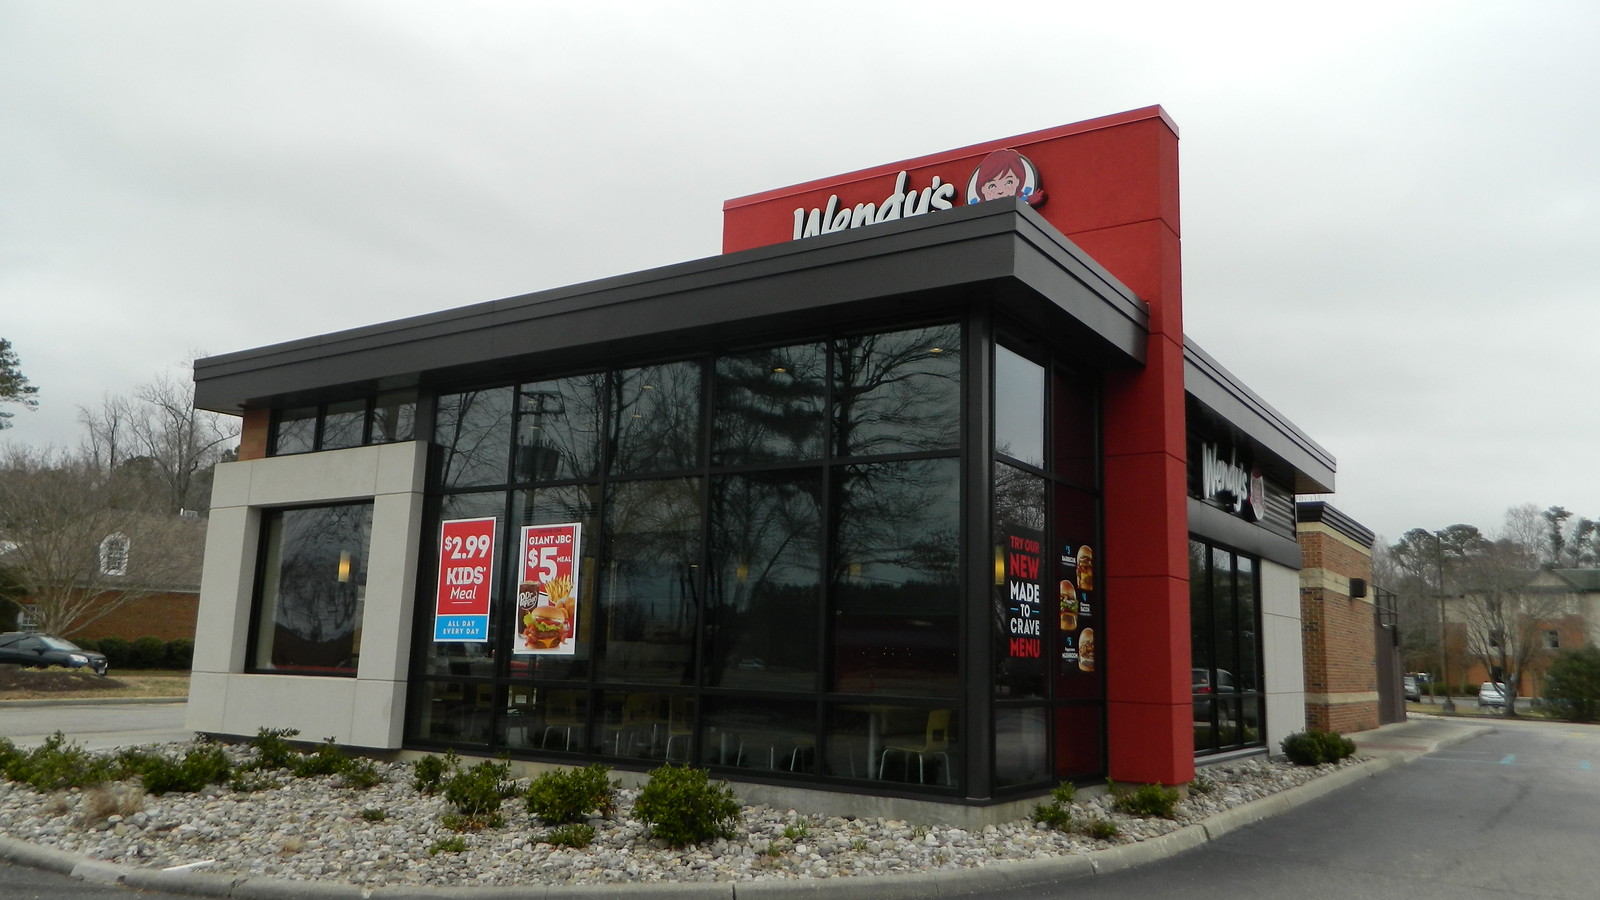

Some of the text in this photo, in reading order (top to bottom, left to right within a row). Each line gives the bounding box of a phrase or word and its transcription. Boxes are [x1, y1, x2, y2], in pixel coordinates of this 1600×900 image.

[793, 170, 954, 241] Wendy's
[1202, 442, 1248, 512] Wendy's
[444, 534, 490, 559] $2.99
[529, 534, 572, 545] GIANT JBC
[1010, 535, 1040, 554] TRY OUR
[446, 566, 487, 585] KIDS'
[528, 547, 572, 584] $5 MEAL
[1010, 553, 1039, 580] NEW
[450, 585, 477, 600] Meal
[1010, 580, 1040, 603] MADE
[1020, 603, 1031, 617] TO
[1010, 617, 1040, 636] CRAVE
[1010, 637, 1040, 659] MENU
